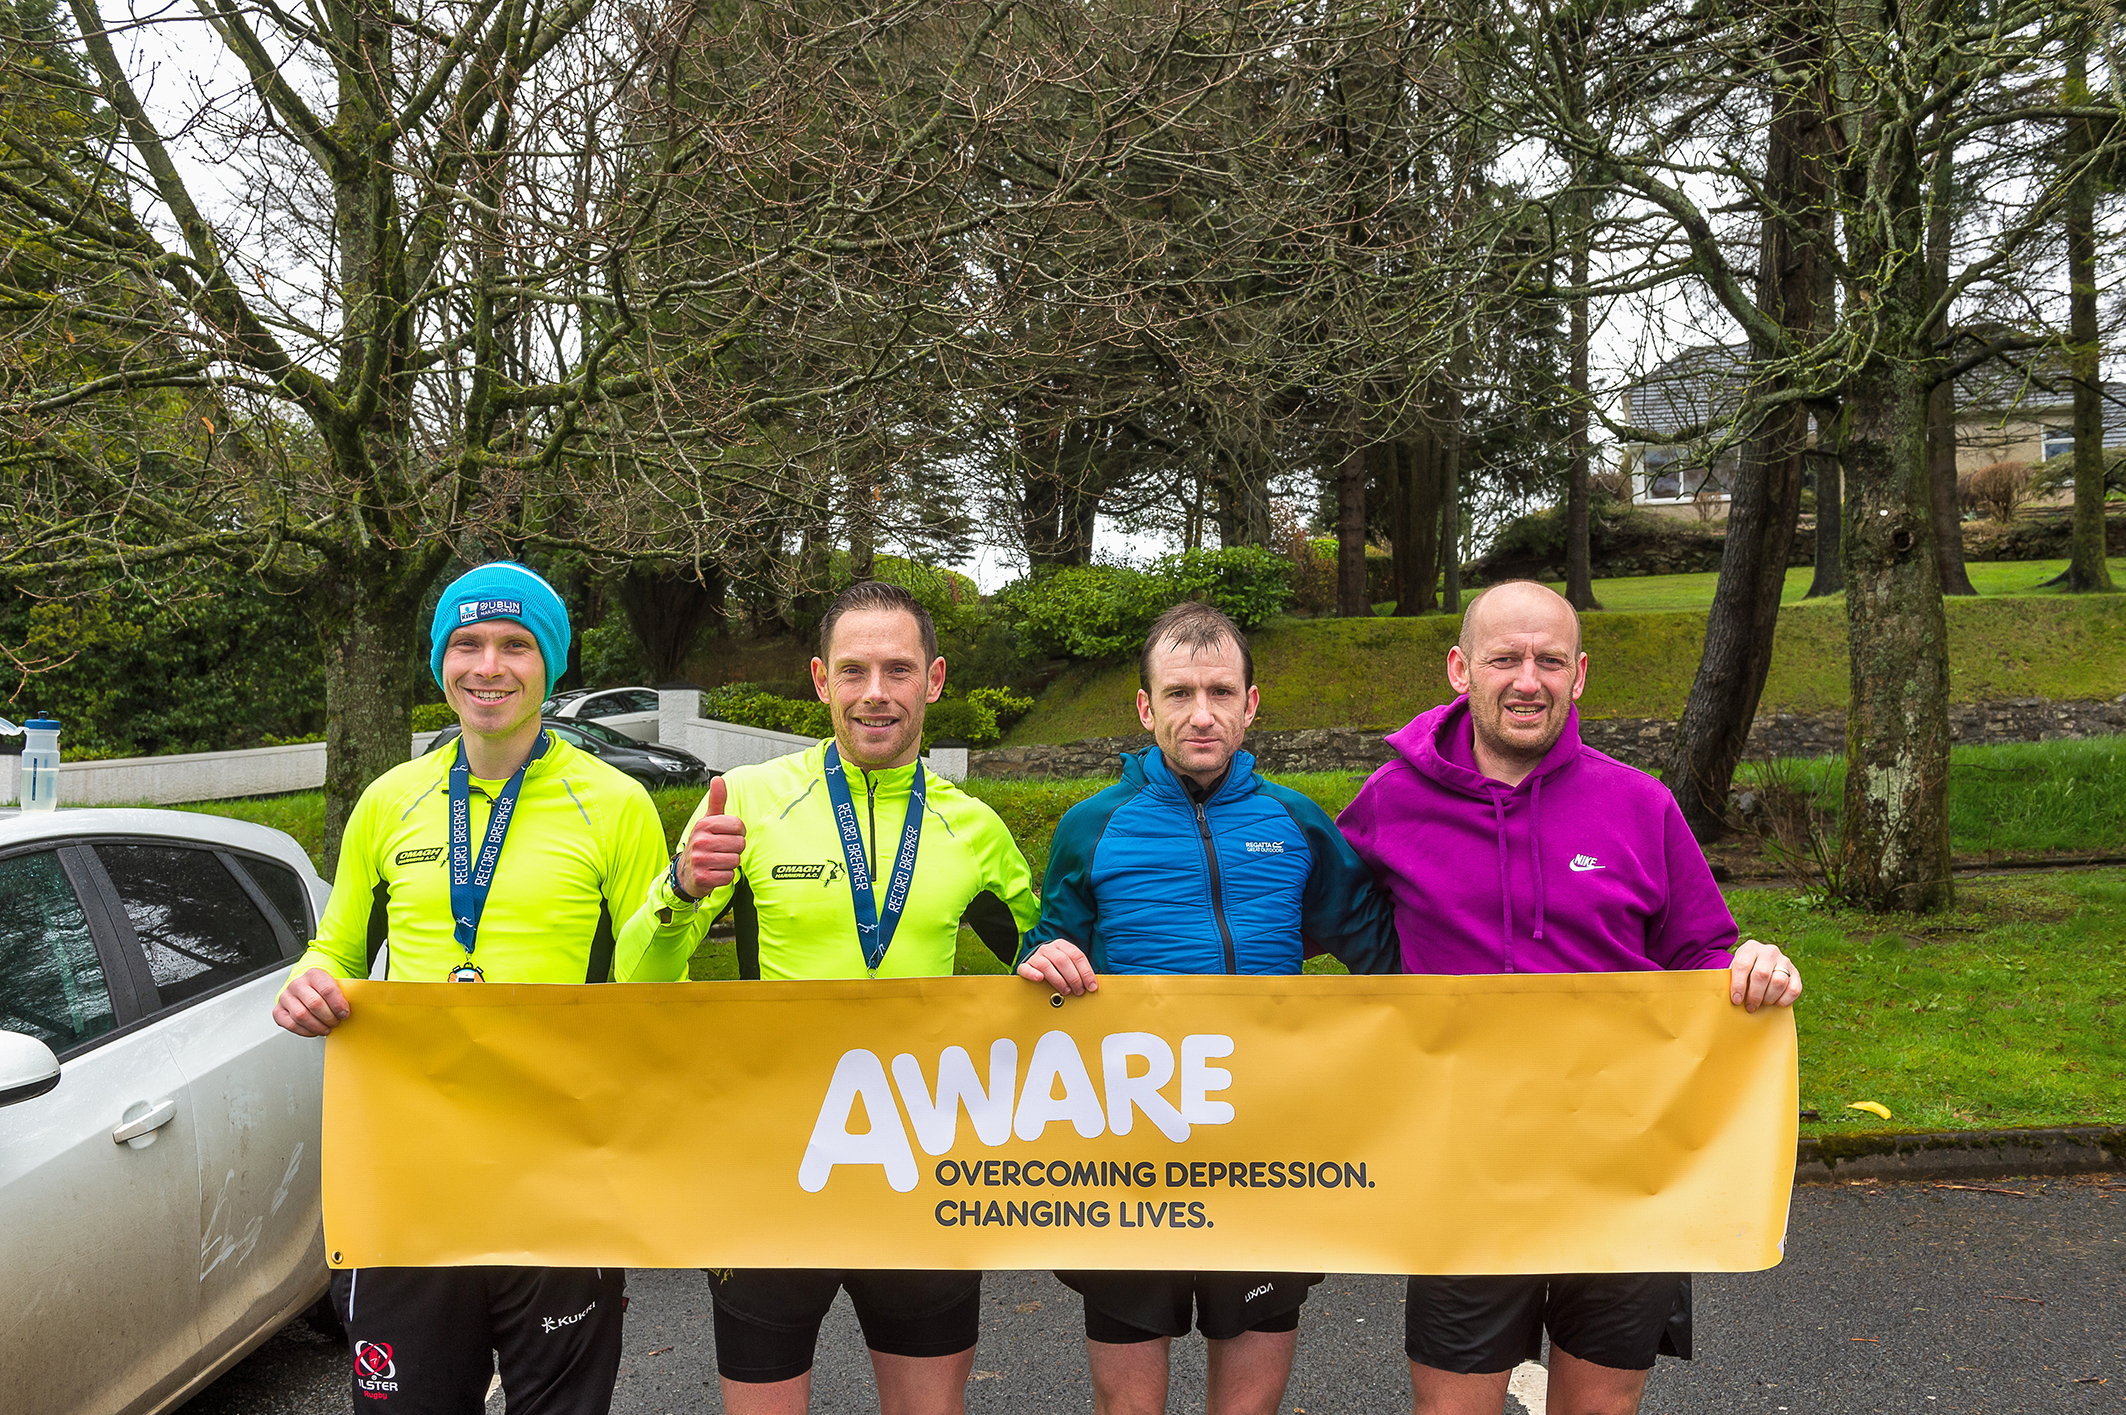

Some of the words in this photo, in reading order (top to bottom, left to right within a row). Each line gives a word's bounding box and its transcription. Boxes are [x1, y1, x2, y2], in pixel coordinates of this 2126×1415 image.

[480, 601, 520, 611] DUBLIN
[453, 798, 466, 844] BREAKER
[837, 802, 858, 841] RECORD
[399, 849, 441, 860] OMAGH
[474, 844, 499, 887] RECORD
[488, 797, 514, 843] BREAKER
[454, 845, 468, 885] RECORD
[776, 865, 822, 874] OMAGH
[846, 843, 869, 891] BREAKER
[888, 870, 909, 914] RECORD
[899, 825, 919, 871] BREAKER
[1574, 853, 1598, 868] NIKE
[798, 1030, 1236, 1193] AWARE
[934, 1160, 1157, 1188] OVERCOMING
[1165, 1161, 1376, 1189] DEPRESSION.
[934, 1201, 1112, 1228] CHANGING
[1119, 1202, 1214, 1229] LIVES.
[556, 1301, 597, 1327] KUKRI
[364, 1390, 388, 1400] Rugby
